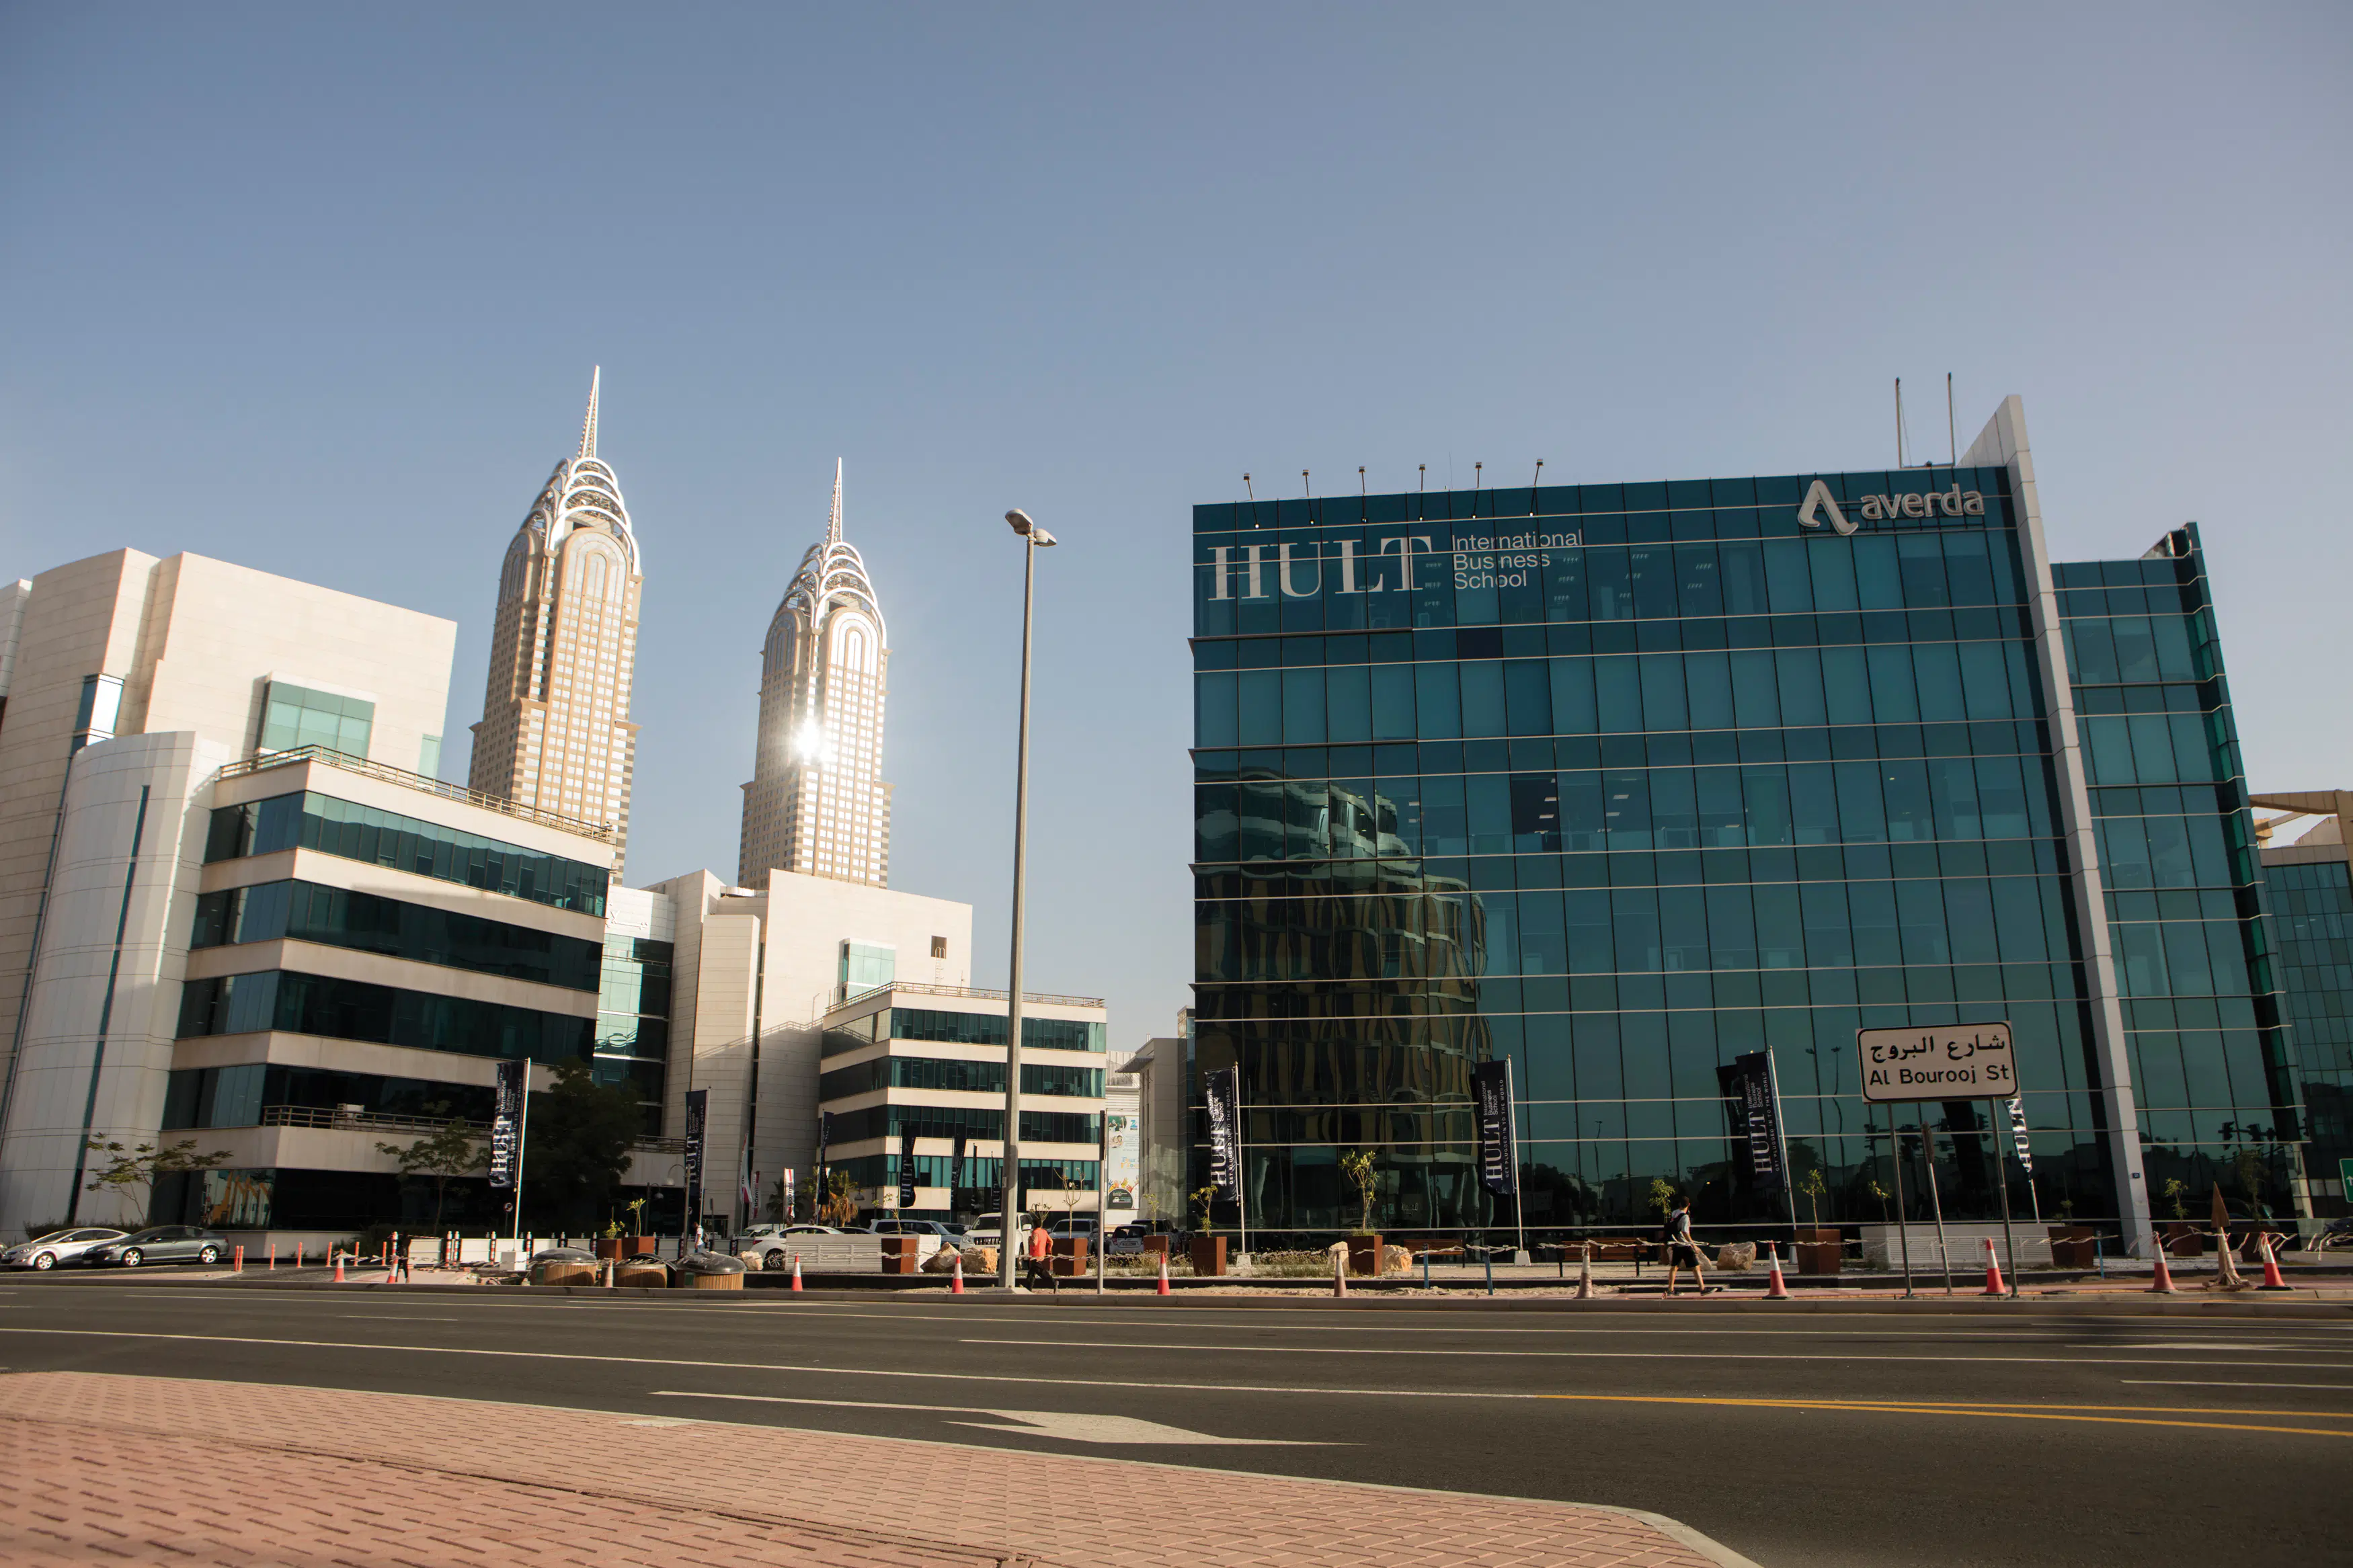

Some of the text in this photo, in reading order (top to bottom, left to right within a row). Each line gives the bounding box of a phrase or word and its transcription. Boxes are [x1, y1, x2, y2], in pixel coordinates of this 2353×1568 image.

[1860, 483, 1985, 520] averda
[1451, 528, 1583, 551] International
[1207, 536, 1433, 601] HULT
[1453, 553, 1551, 571] Busness
[1454, 570, 1527, 590] School
[1870, 1032, 2005, 1064] شارع البروج
[1870, 1064, 2009, 1085] Al Bourooj St
[1743, 1073, 1752, 1108] International
[1749, 1081, 1757, 1108] Business
[1227, 1123, 1232, 1131] TO
[1502, 1117, 1506, 1126] TO
[1767, 1109, 1771, 1118] TO
[491, 1115, 513, 1173] HULT
[1210, 1125, 1227, 1186] HULT
[1483, 1119, 1503, 1181] HULT
[1749, 1111, 1773, 1175] HULT
[1769, 1128, 1778, 1158] PLUGGED
[901, 1159, 913, 1199] HULT
